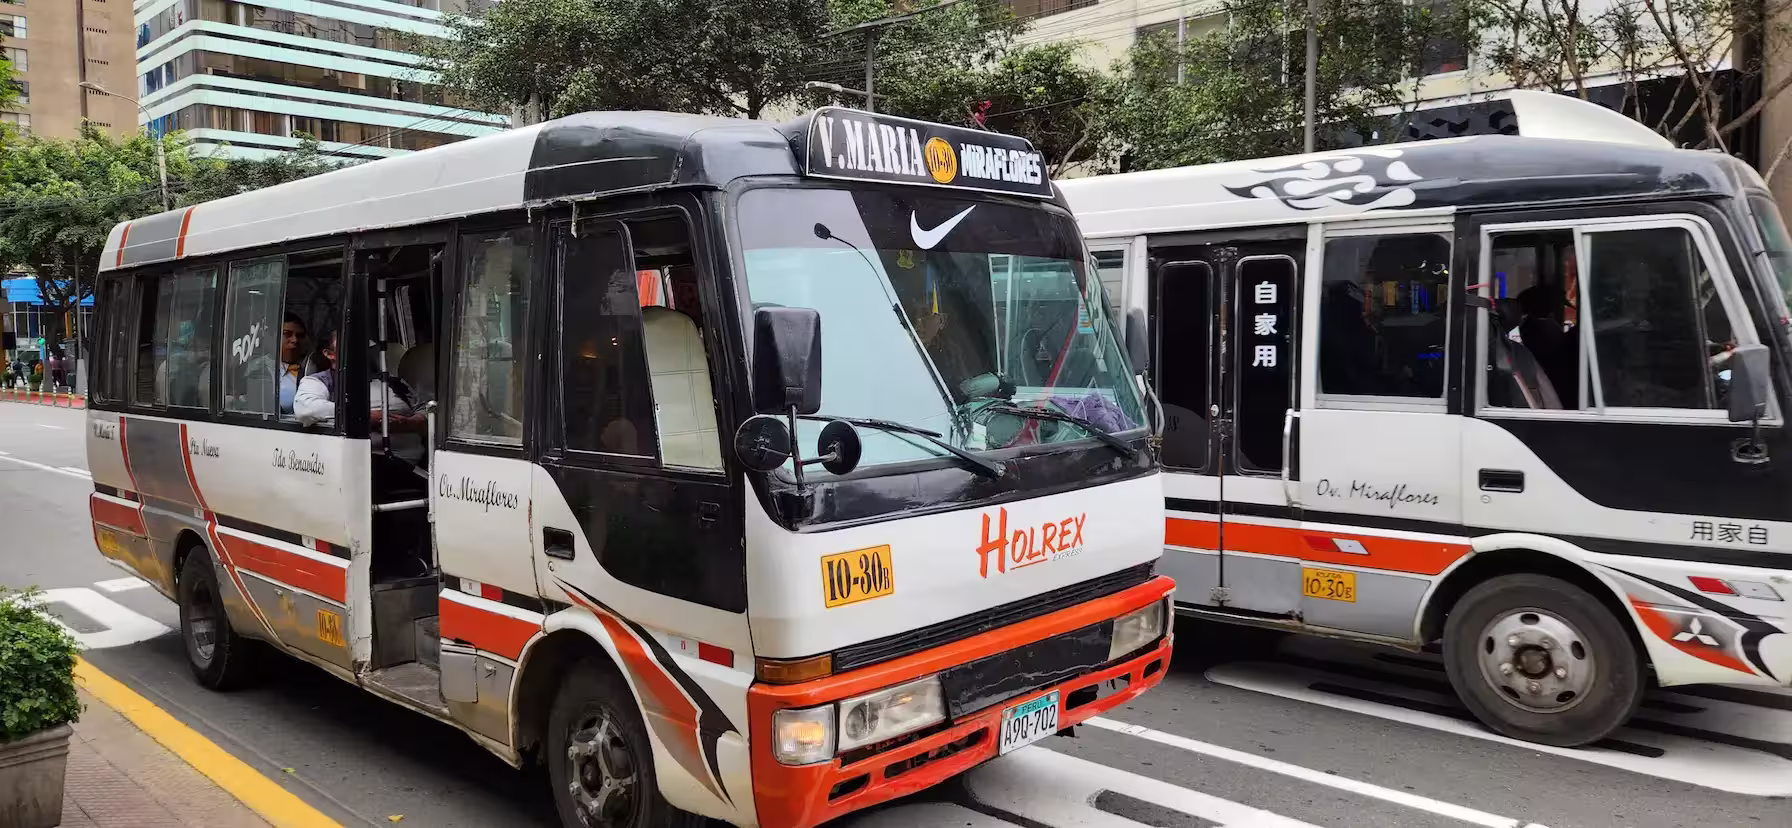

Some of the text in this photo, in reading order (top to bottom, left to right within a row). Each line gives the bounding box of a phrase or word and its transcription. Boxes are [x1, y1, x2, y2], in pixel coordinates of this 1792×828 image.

[959, 142, 1042, 185] MIRAFLORES
[1251, 280, 1278, 367] 自家用
[1349, 480, 1439, 509] Miraflores
[1003, 703, 1057, 747] A9Q-702
